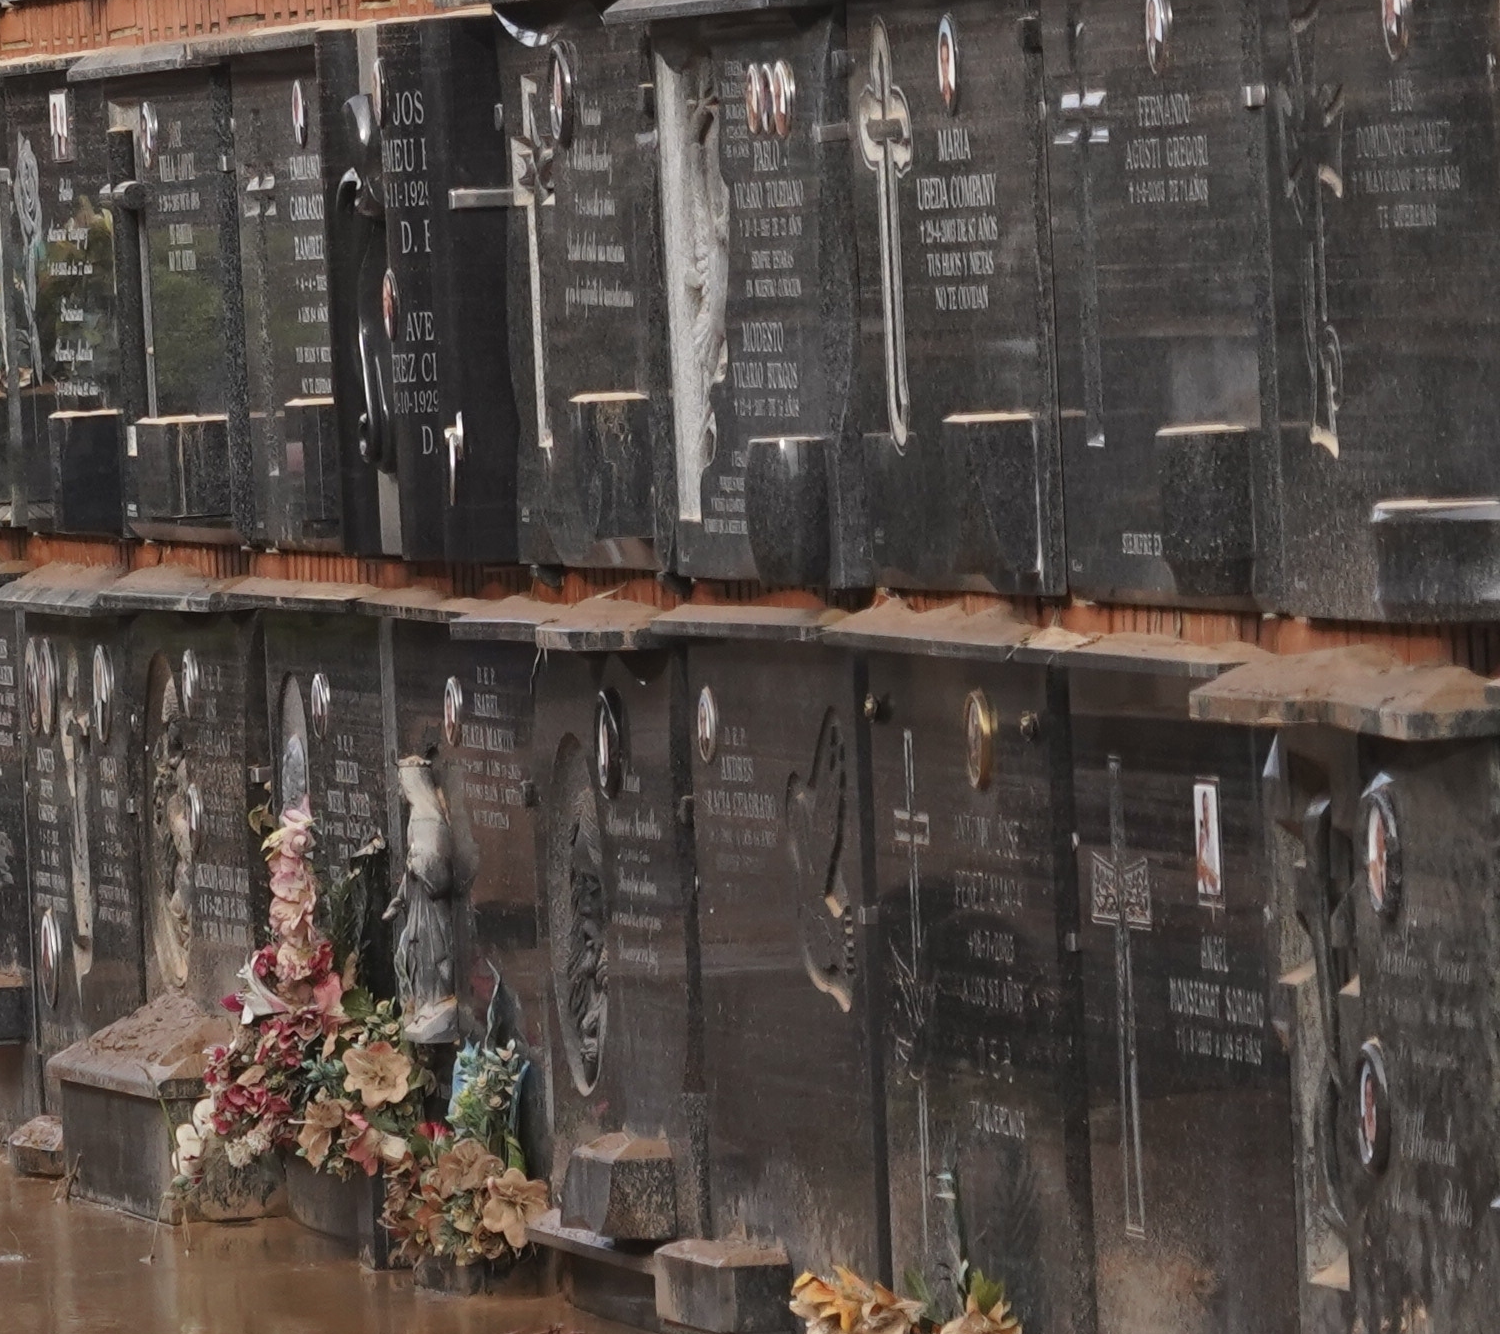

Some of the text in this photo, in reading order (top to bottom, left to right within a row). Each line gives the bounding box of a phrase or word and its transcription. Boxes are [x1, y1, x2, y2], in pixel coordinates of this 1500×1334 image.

[1137, 93, 1190, 127] FERNANDO
[937, 128, 971, 162] MARIA
[916, 173, 997, 211] UBEDA COMPANY
